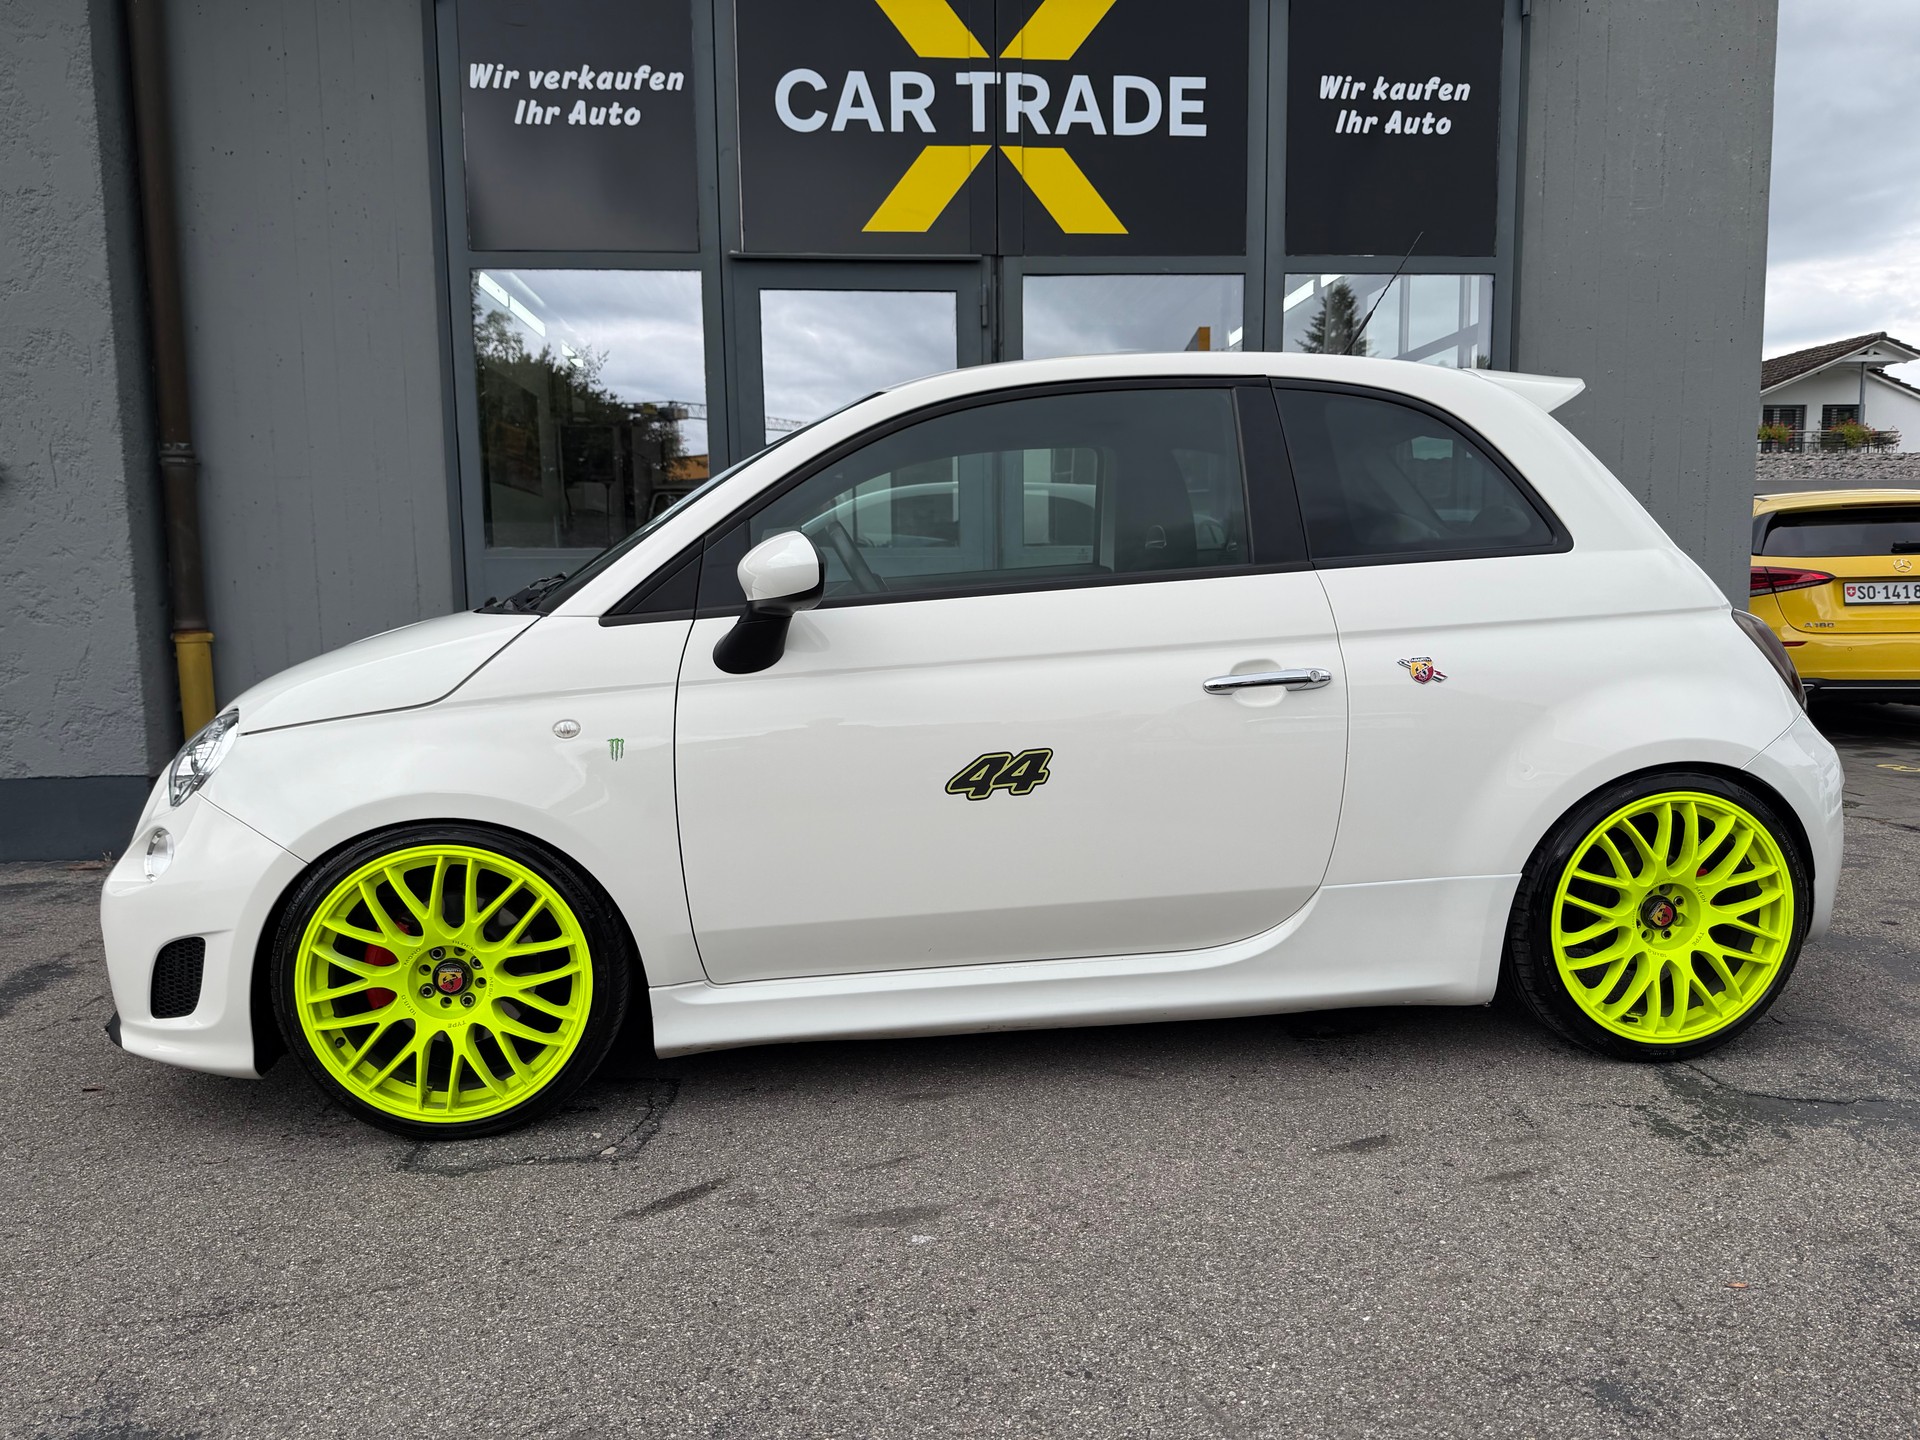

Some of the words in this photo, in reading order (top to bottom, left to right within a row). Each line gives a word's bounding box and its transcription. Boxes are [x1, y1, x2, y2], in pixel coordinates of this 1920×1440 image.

[469, 63, 520, 89] Wir
[528, 64, 685, 92] verkaufen
[1319, 75, 1367, 101] Wir
[1372, 75, 1472, 103] kaufen
[514, 99, 561, 125] Ihr
[567, 99, 642, 127] Auto
[775, 68, 937, 133] CAR
[955, 73, 1208, 137] TRADE
[1335, 109, 1379, 135] Ihr
[1384, 110, 1453, 136] Auto
[945, 748, 1053, 801] 44
